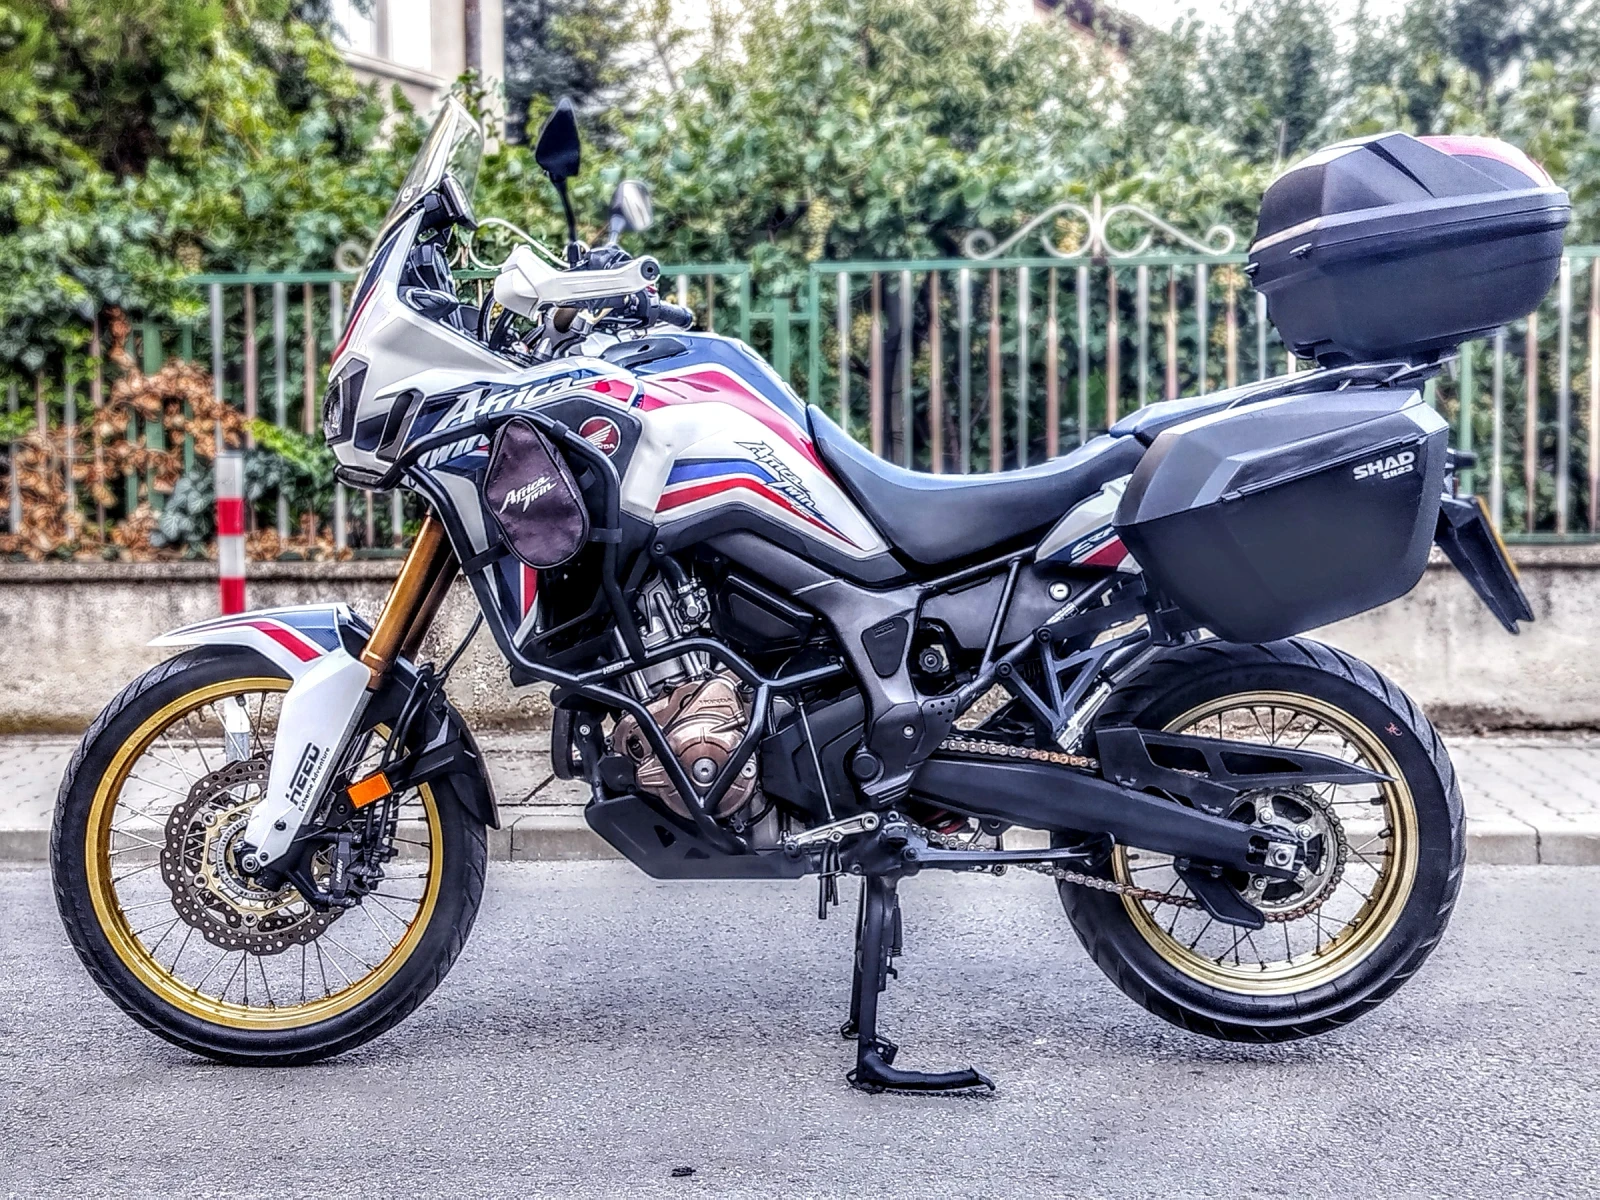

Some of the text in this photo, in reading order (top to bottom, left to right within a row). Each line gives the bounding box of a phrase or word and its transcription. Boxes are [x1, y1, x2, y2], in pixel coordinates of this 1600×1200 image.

[431, 377, 607, 433] Africa
[733, 440, 812, 494] Africa
[1352, 451, 1415, 480] SHAD
[499, 476, 550, 514] Africa
[520, 482, 557, 513] Twin
[765, 481, 826, 517] Twin
[298, 747, 331, 812] Extreme Adventure
